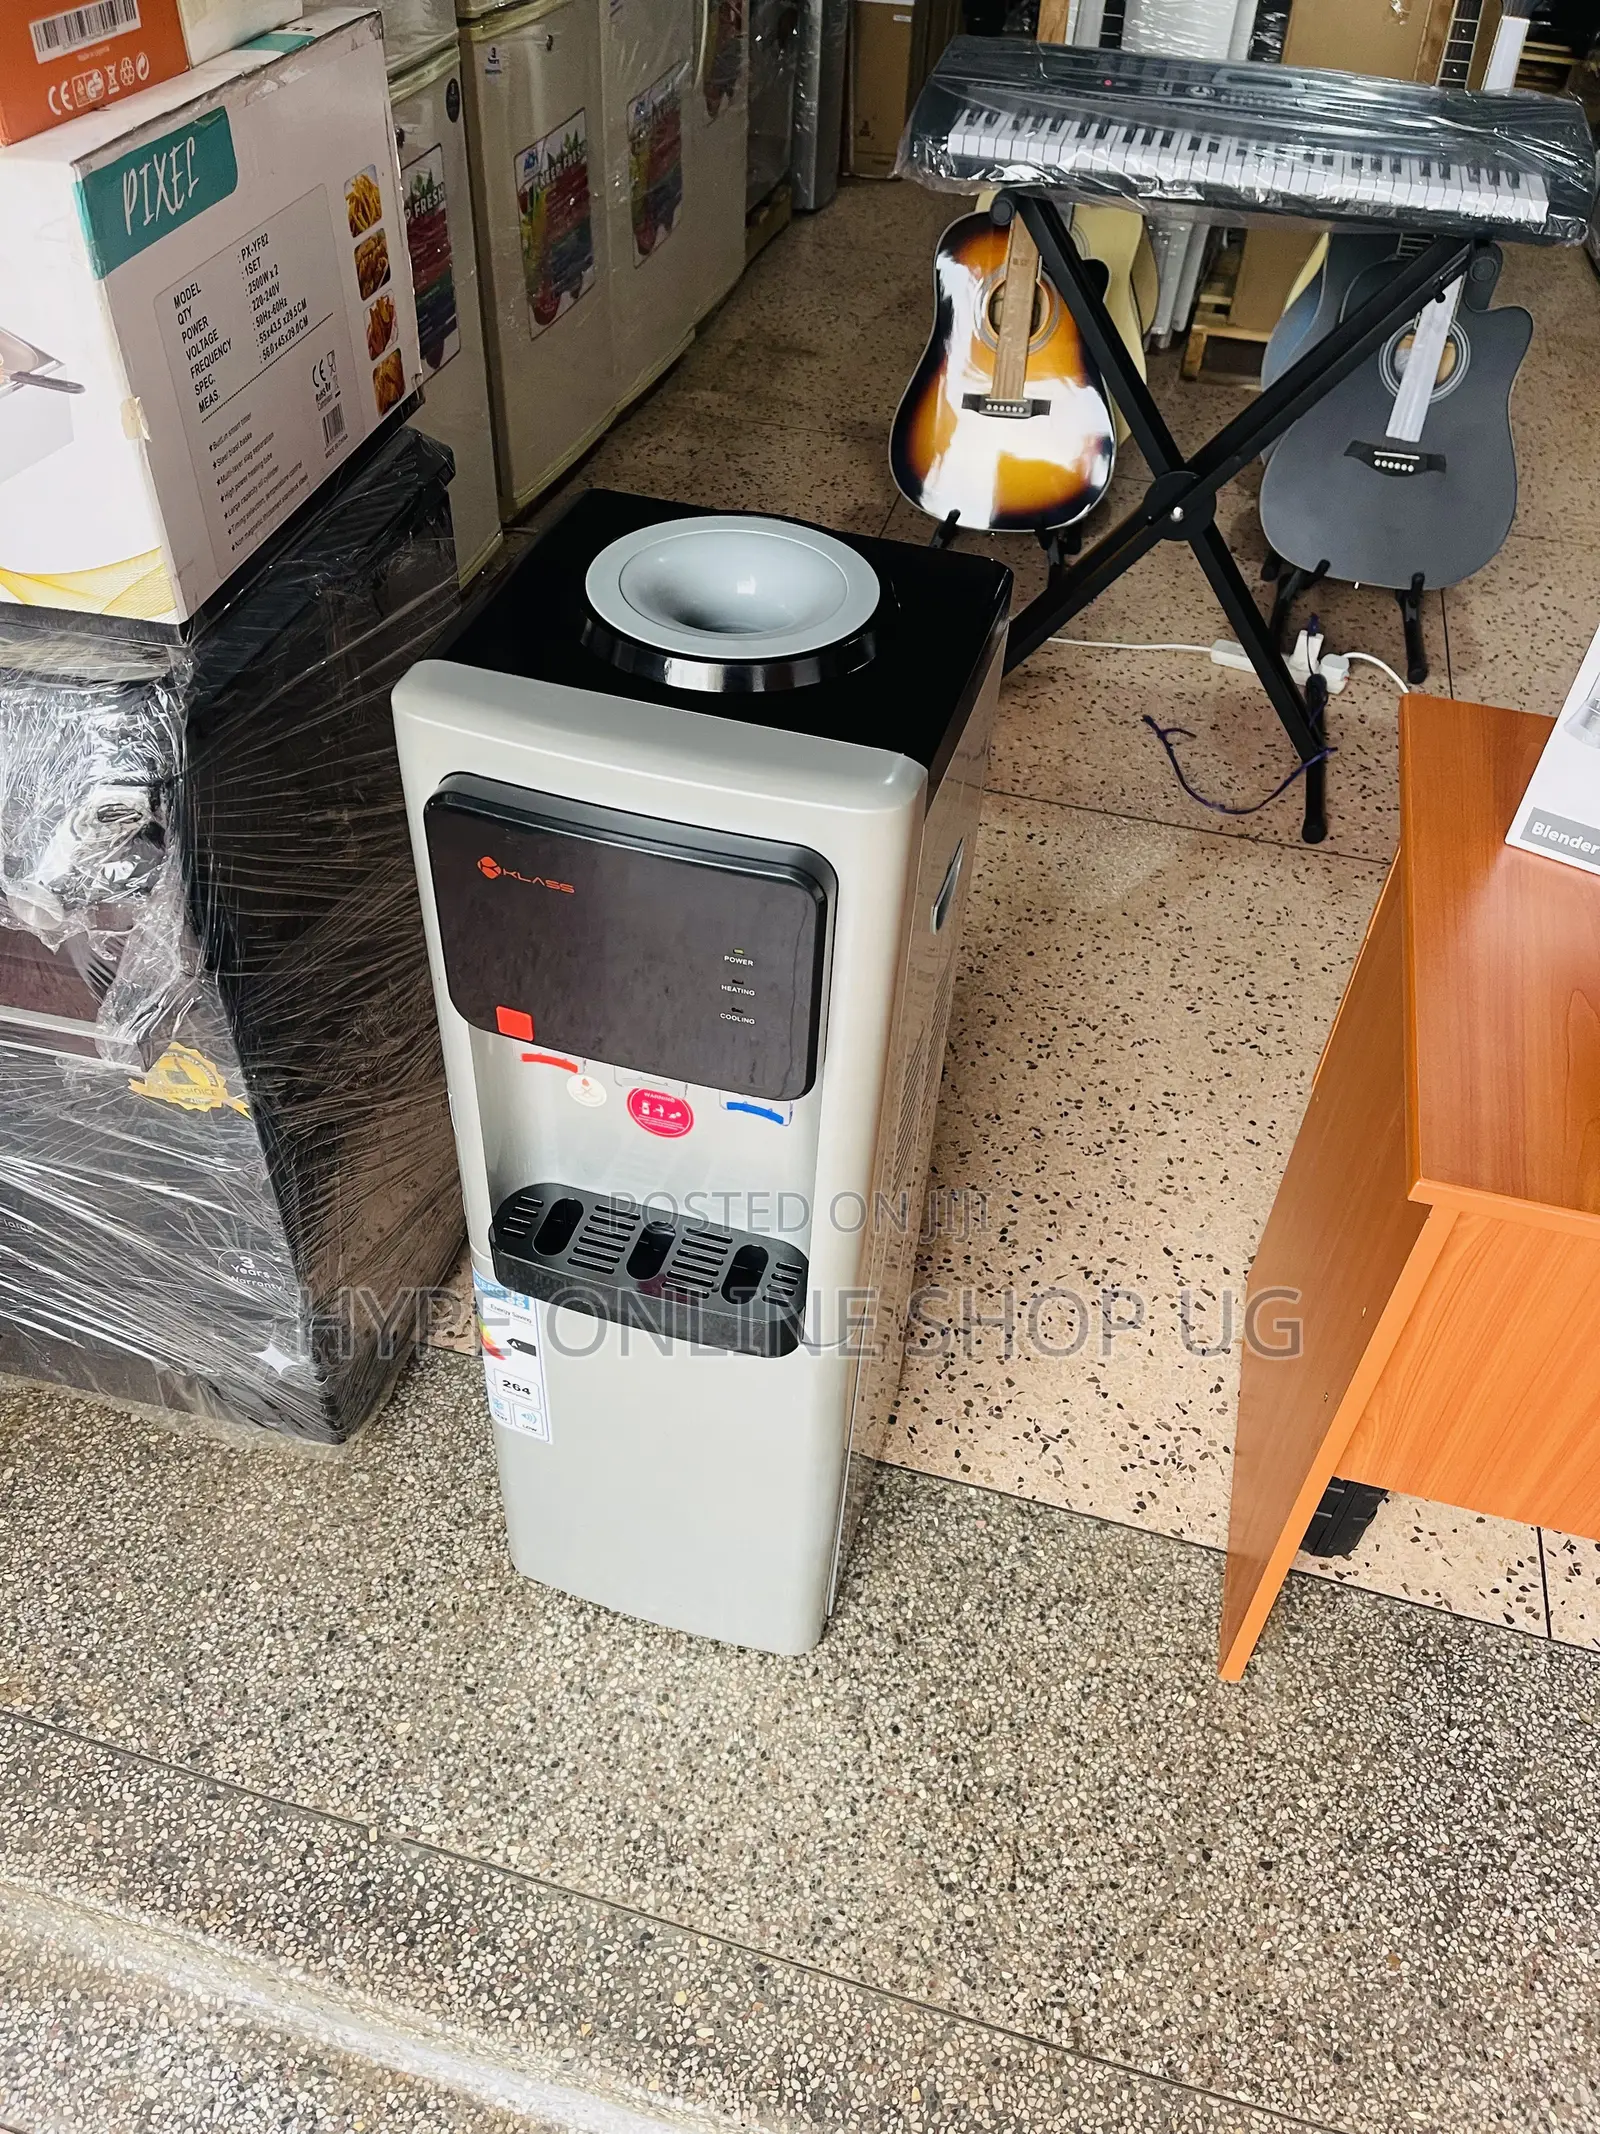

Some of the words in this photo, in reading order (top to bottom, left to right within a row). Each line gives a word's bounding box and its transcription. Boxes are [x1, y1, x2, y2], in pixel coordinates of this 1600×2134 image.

[123, 136, 199, 236] PIXEL
[414, 182, 446, 218] FRESH
[173, 282, 202, 309] MODEL
[241, 233, 269, 261] PX-YF82
[177, 306, 193, 326] QTY
[244, 257, 261, 276] 1SET
[181, 315, 209, 344] POWER
[185, 328, 219, 361] VOLTAGE
[190, 338, 232, 379] FREQUENCY
[194, 373, 216, 396] SPEC.
[198, 389, 220, 413] MEAS.
[1531, 821, 1600, 855] Blender
[503, 868, 575, 894] KLASS
[724, 955, 754, 966] POWER
[721, 984, 755, 996] HEATING
[720, 1013, 755, 1025] COOLING
[231, 1264, 270, 1278] Years
[240, 1256, 255, 1269] 3
[231, 1276, 282, 1291] Warranty
[503, 1380, 531, 1395] 264
